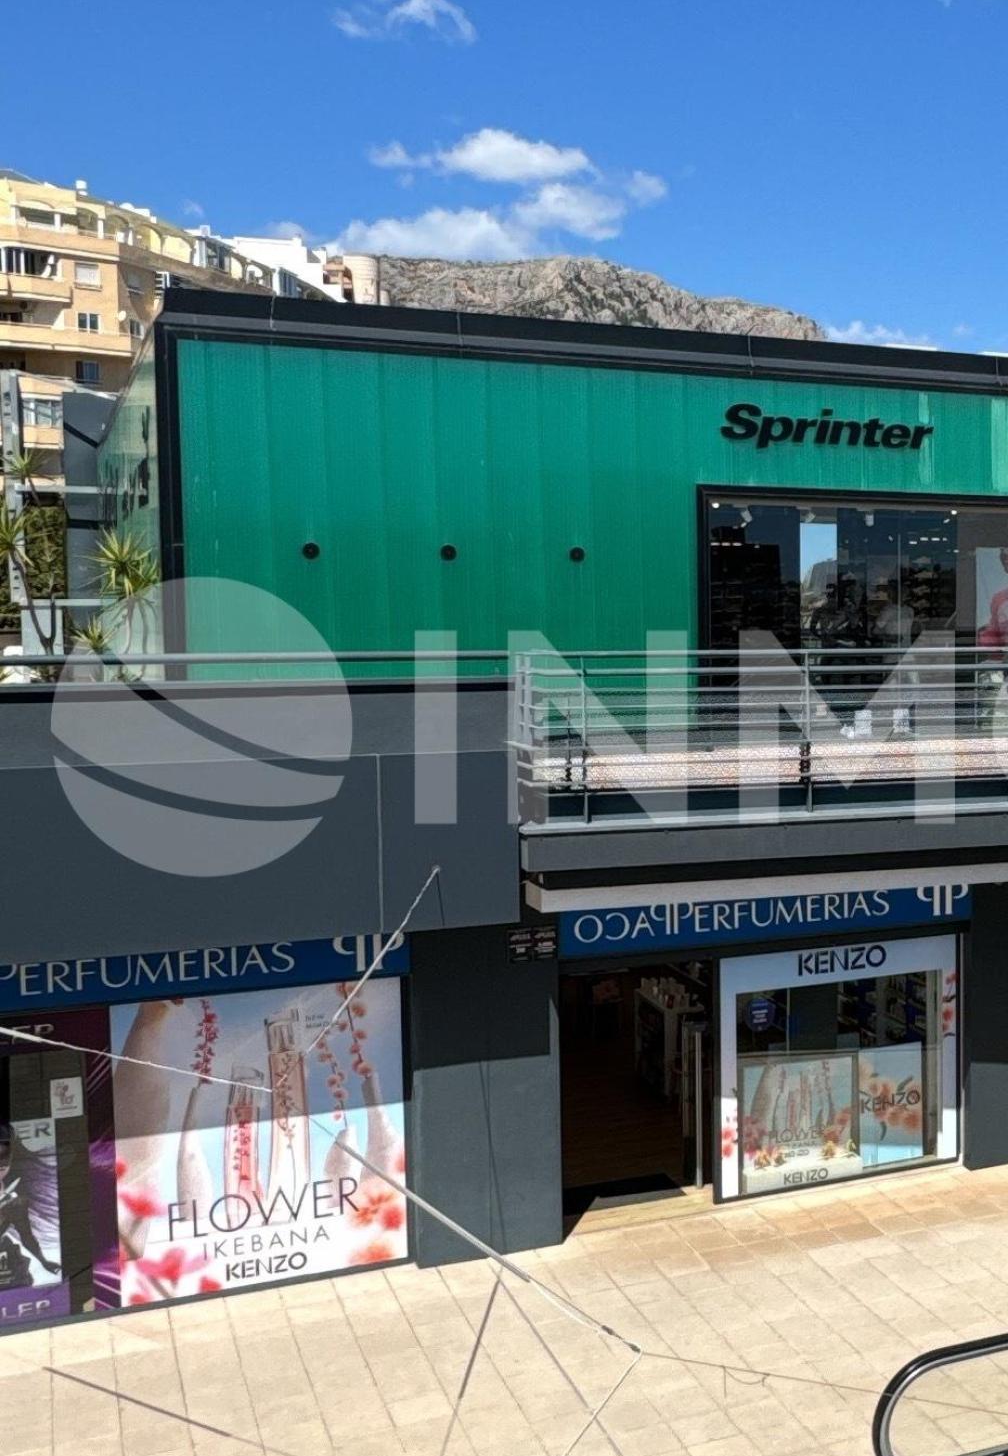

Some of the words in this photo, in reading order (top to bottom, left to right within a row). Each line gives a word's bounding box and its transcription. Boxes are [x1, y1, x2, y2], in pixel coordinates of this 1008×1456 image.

[720, 403, 935, 450] Sprinter
[673, 890, 890, 935] PERFUMERIAS
[798, 945, 887, 976] KENZO
[783, 1167, 830, 1185] KENZO
[168, 1177, 360, 1241] FLOWER
[203, 1225, 330, 1260] IKEBANA
[226, 1251, 308, 1281] KENZO
